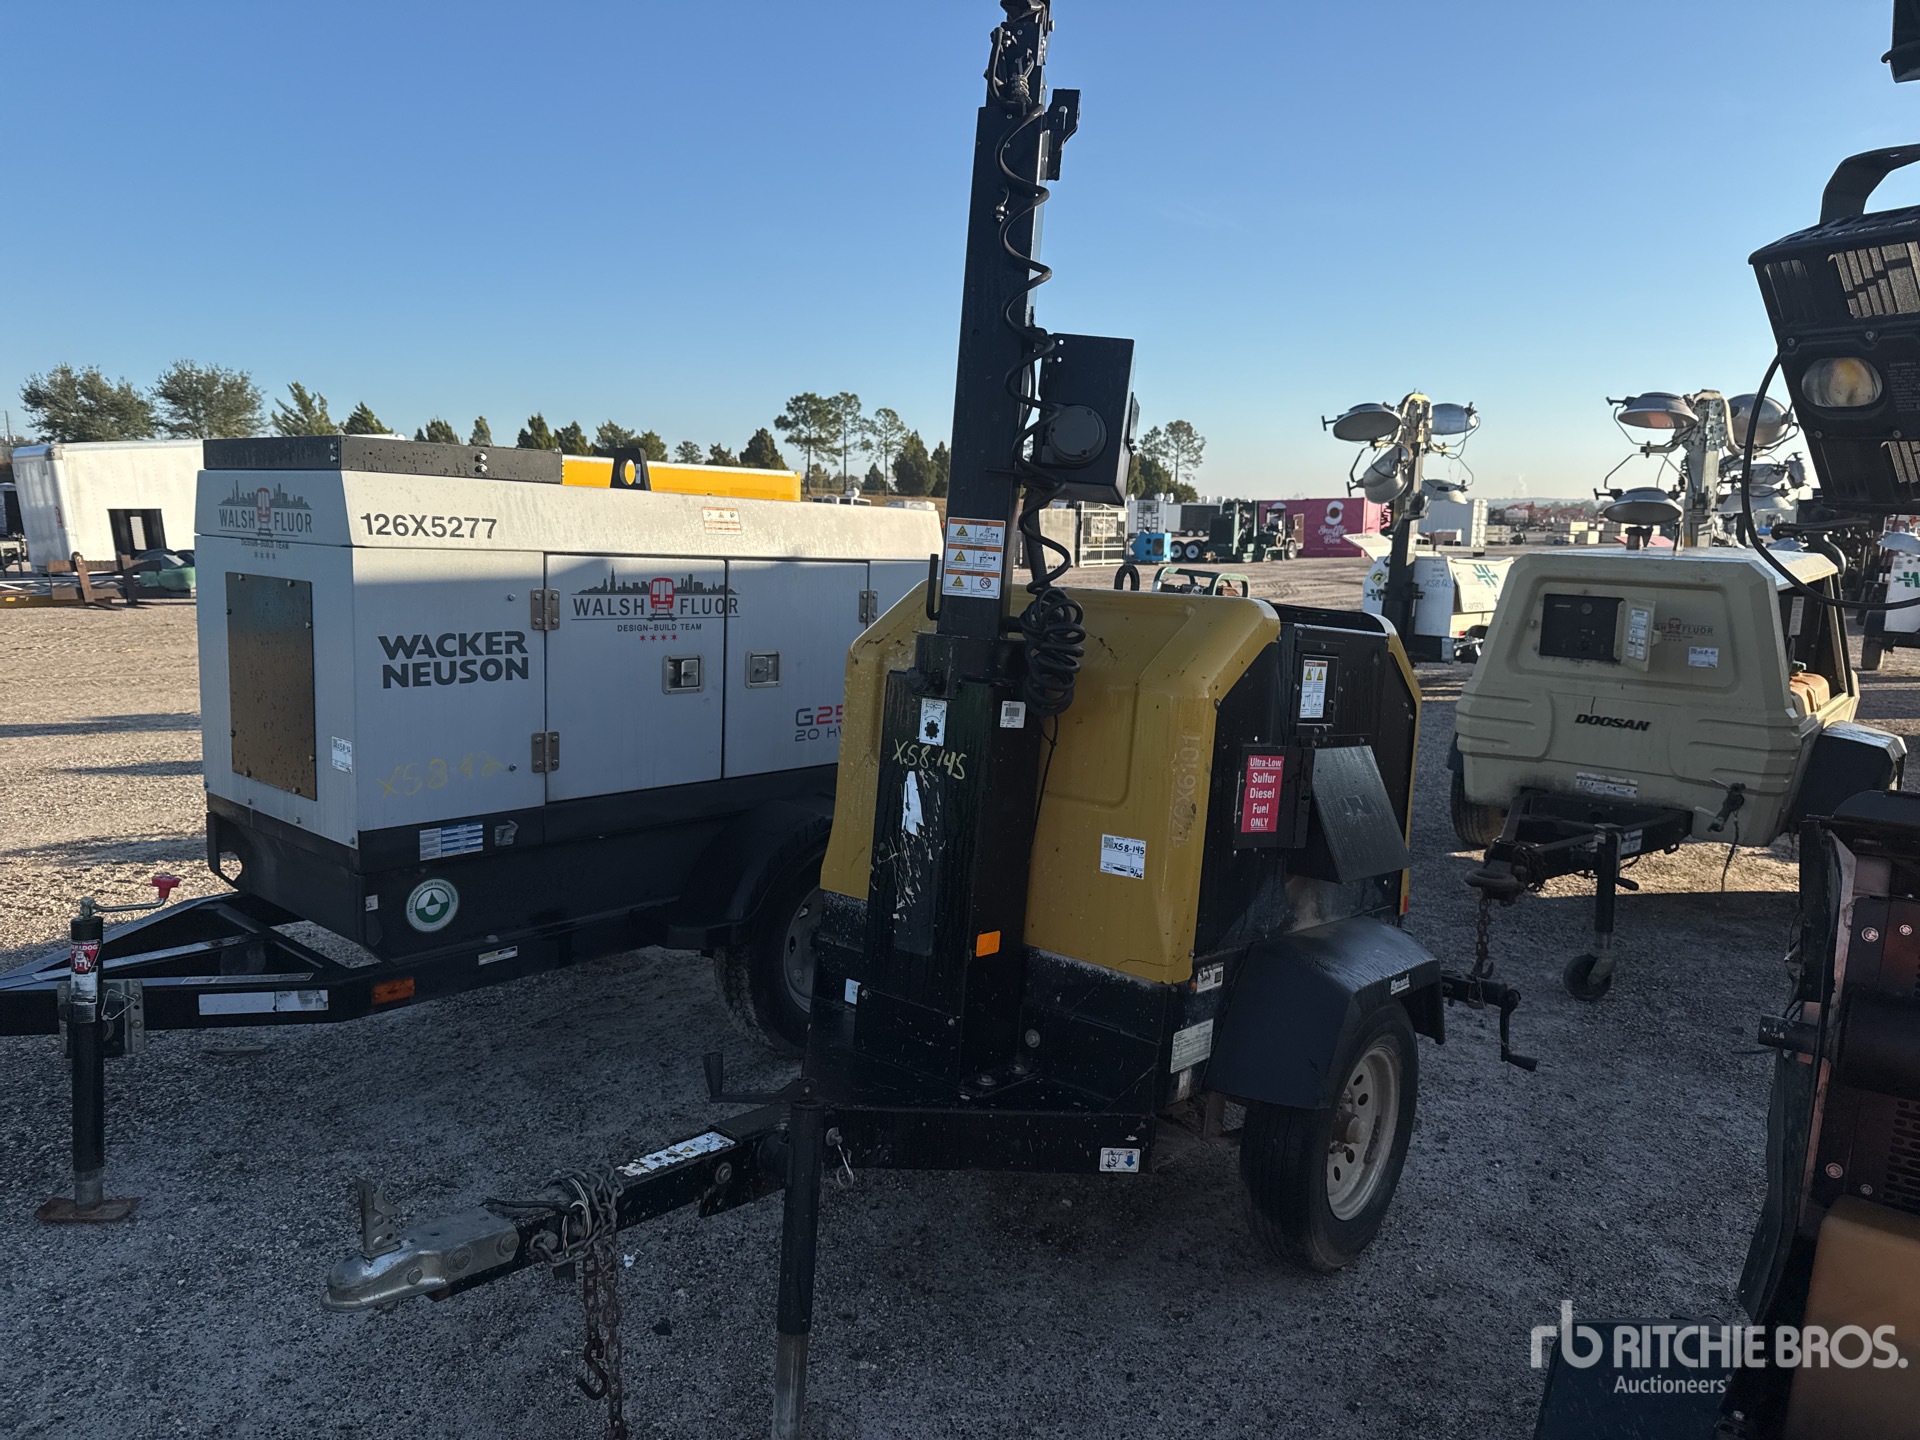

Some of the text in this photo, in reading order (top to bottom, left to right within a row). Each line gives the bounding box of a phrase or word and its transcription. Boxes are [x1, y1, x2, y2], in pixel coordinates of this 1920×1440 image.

[219, 509, 313, 533] WALSH FLUOR
[361, 513, 497, 539] 126X5277
[573, 597, 738, 617] WALSH FLUOR
[617, 623, 702, 632] DESIGN-BUILD TEAM
[1682, 626, 1713, 634] FLUOR
[378, 631, 529, 660] WACKER
[382, 657, 529, 688] NEUSON
[1575, 713, 1650, 731] DOOSAN
[795, 728, 820, 742] 20
[1250, 757, 1282, 767] Ultra-Low
[1252, 772, 1276, 784] Sulfur
[1250, 787, 1275, 799] Diesel
[1252, 803, 1269, 814] Fuel
[1250, 818, 1269, 827] ONLY
